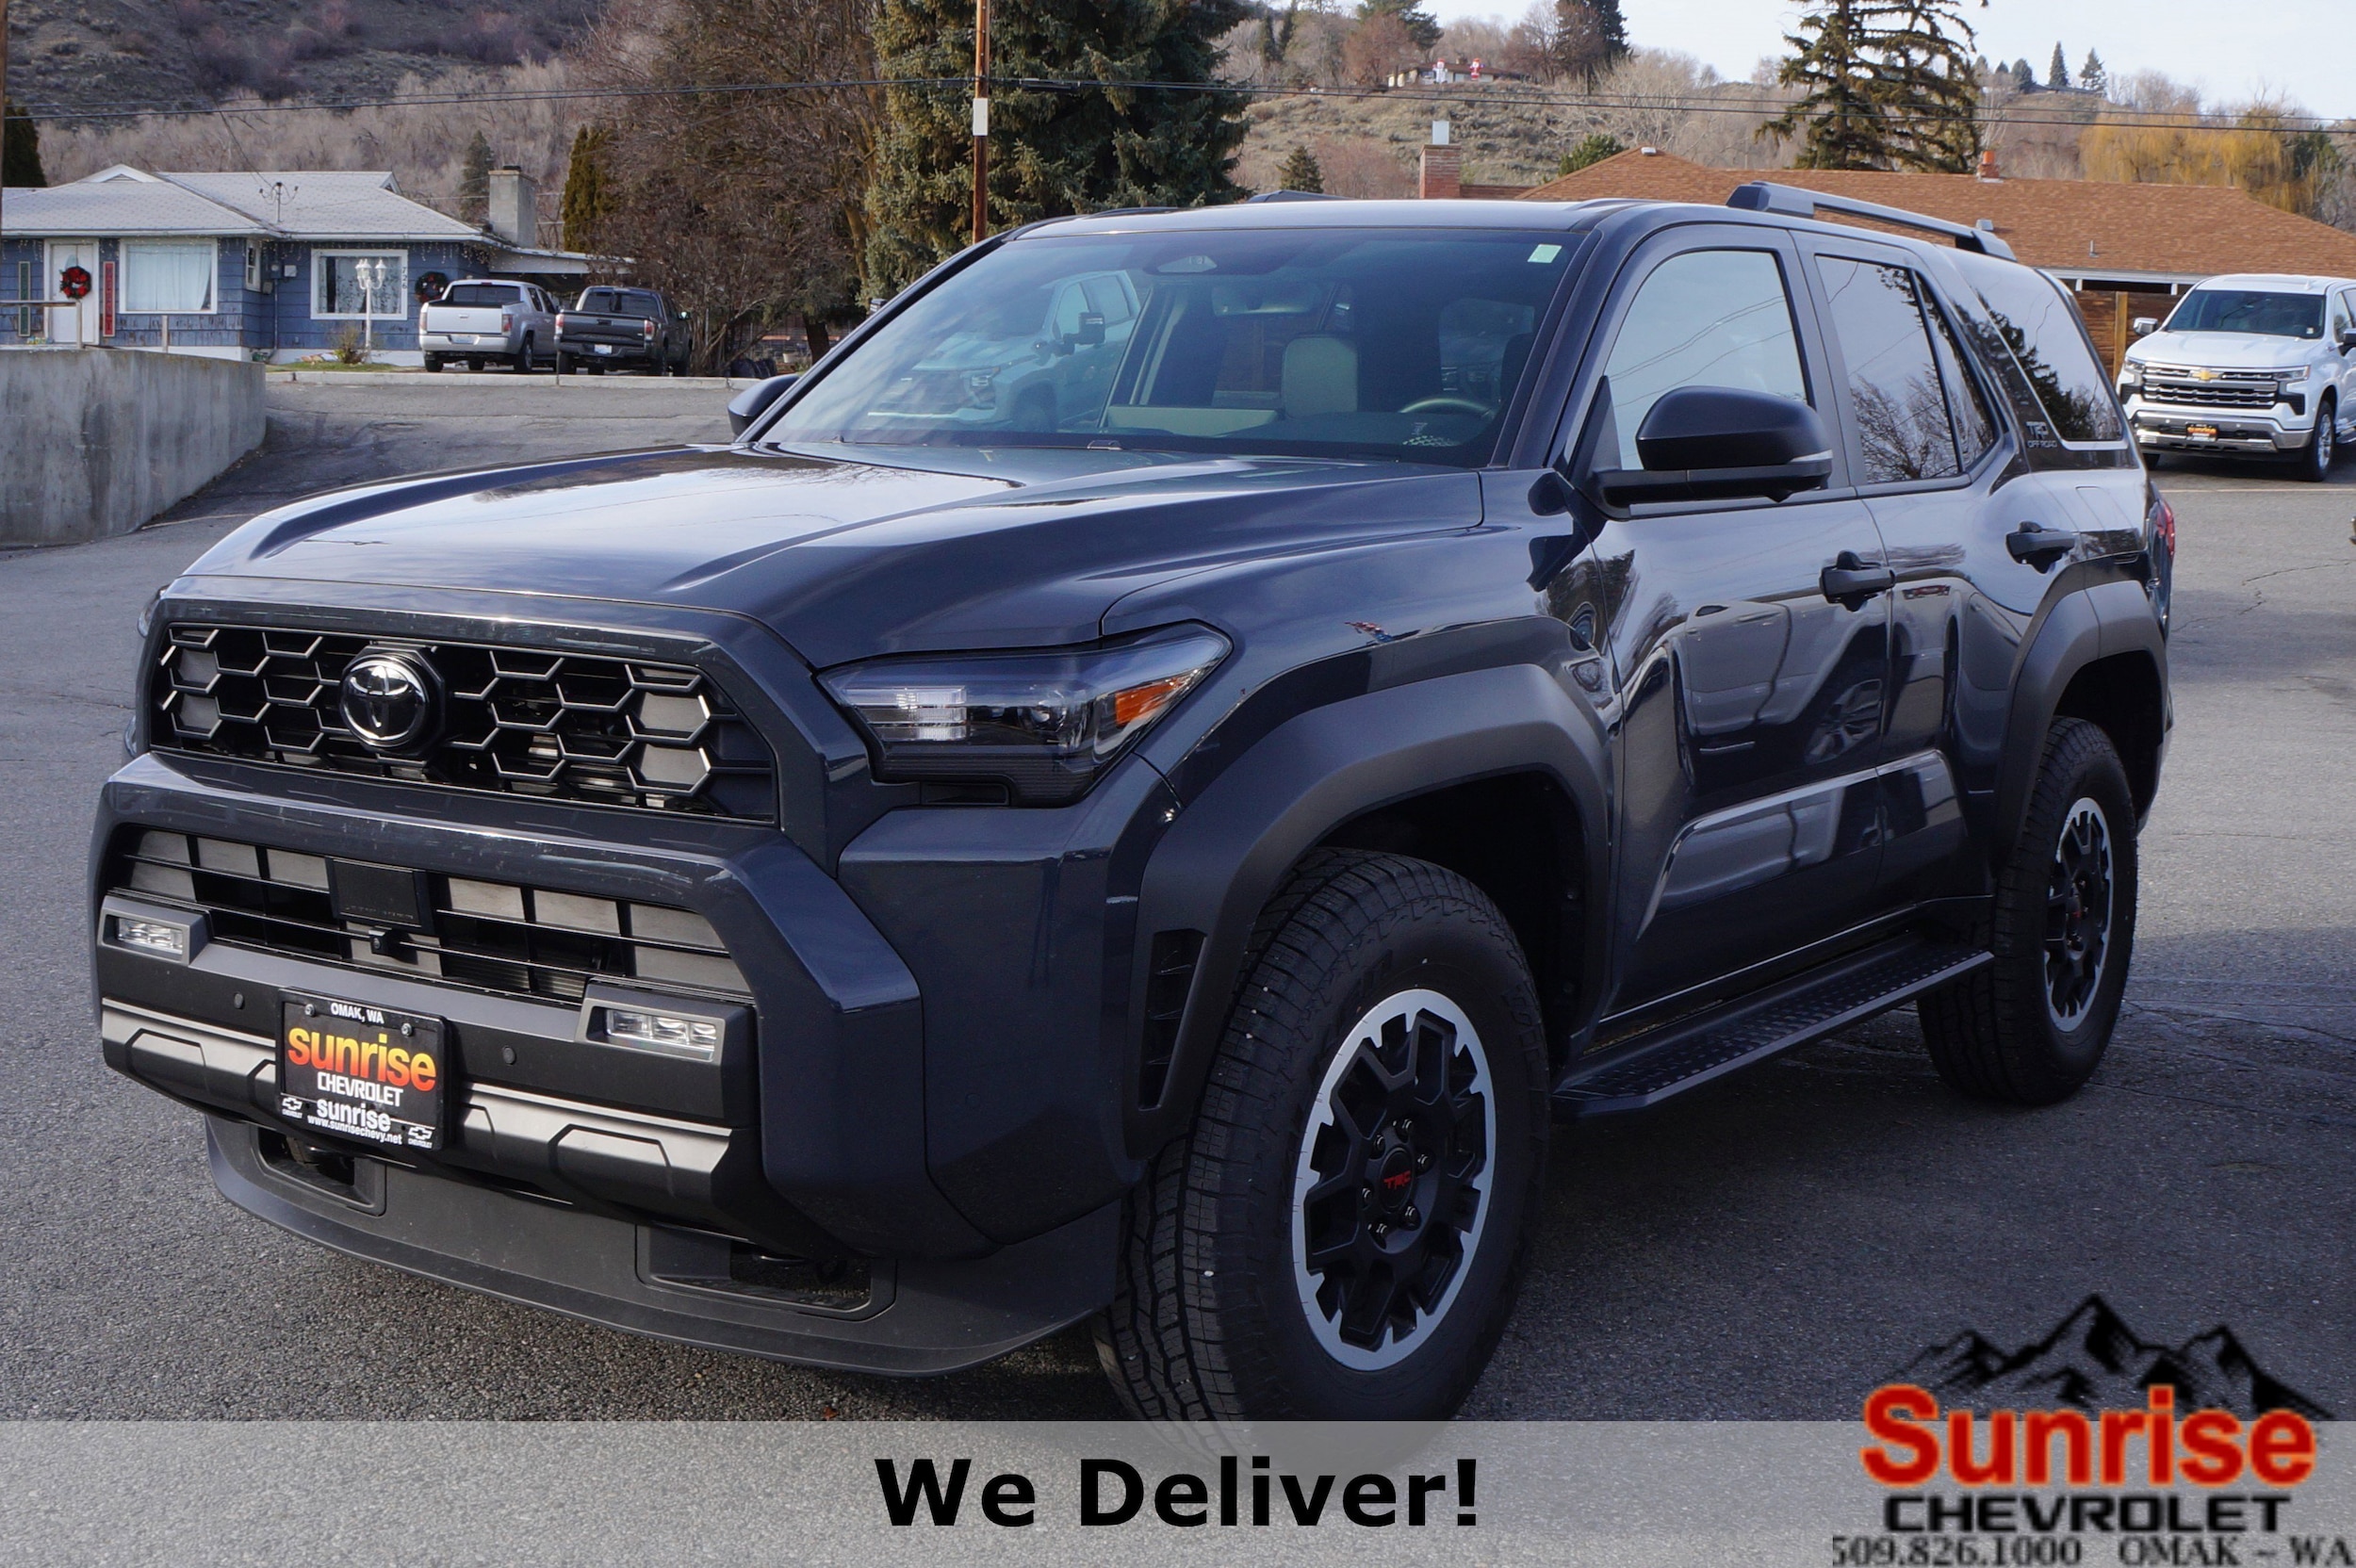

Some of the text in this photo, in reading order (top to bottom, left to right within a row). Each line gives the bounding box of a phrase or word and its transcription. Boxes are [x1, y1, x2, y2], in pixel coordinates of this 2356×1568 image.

[330, 1002, 384, 1024] OMAK, WA
[287, 1027, 436, 1091] sunrise
[317, 1071, 404, 1107] CHEVROLET
[307, 1115, 402, 1145] www.sunrisechevy.net
[317, 1099, 391, 1133] sunrise
